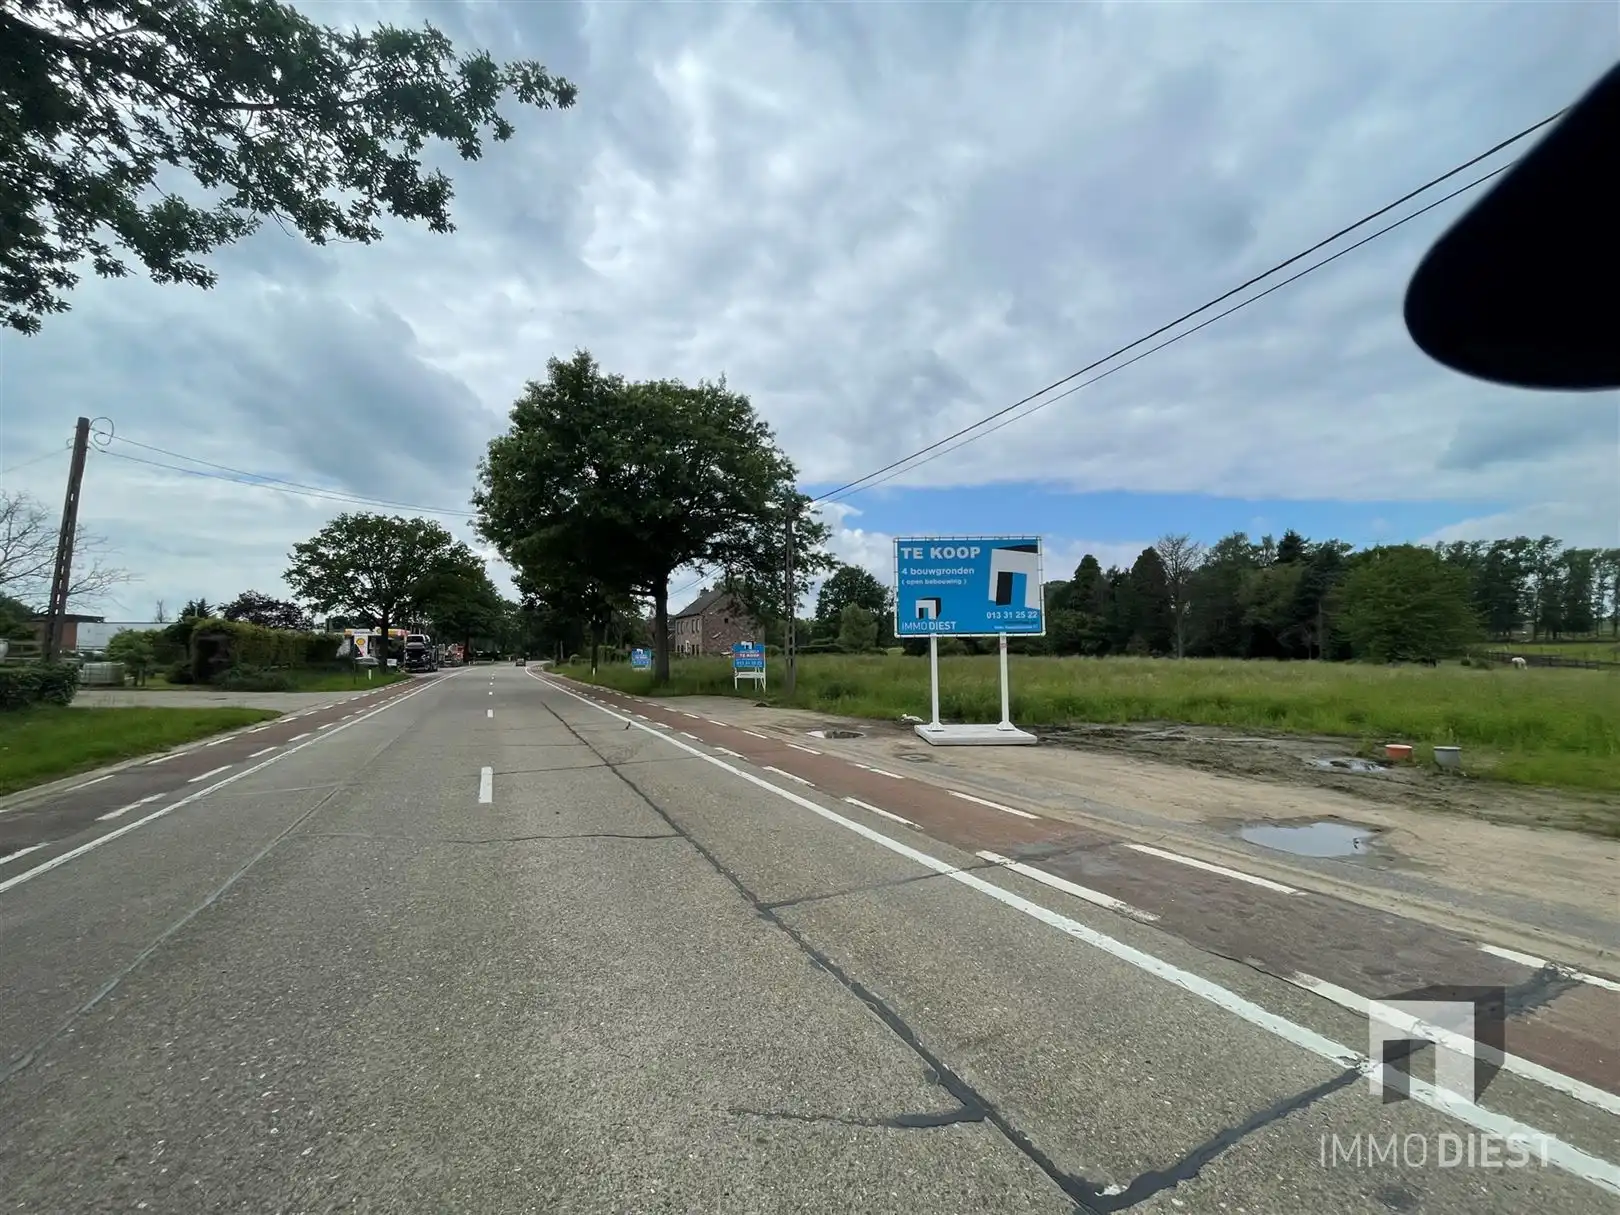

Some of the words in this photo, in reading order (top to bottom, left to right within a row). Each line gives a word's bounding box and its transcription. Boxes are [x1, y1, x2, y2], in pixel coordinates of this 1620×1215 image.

[900, 547, 923, 559] TE
[930, 546, 980, 559] KOOP
[901, 567, 908, 575] 4
[910, 566, 975, 576] bouwgronden
[986, 611, 1001, 619] 013
[1003, 611, 1013, 619] 31
[1015, 610, 1026, 619] 25
[1027, 610, 1038, 619] 22
